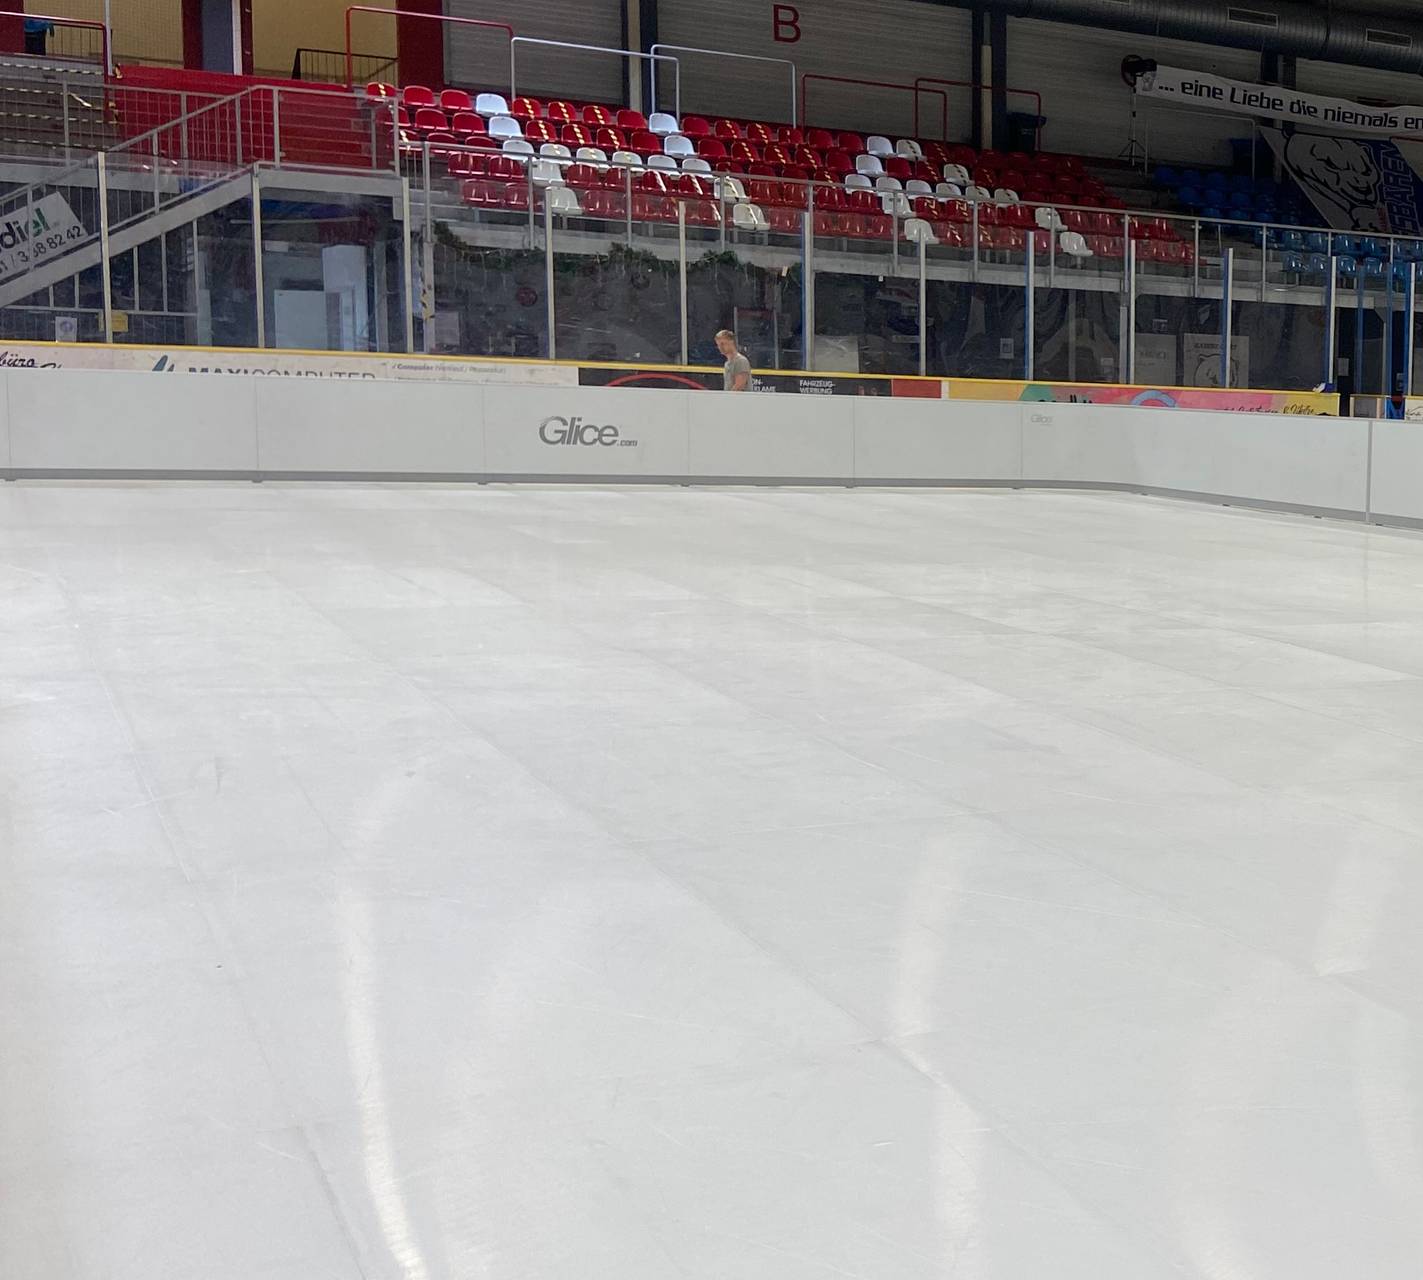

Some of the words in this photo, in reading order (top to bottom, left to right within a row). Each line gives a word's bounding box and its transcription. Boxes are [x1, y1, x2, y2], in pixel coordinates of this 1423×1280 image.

[773, 4, 801, 43] B
[1180, 80, 1224, 100] eine
[1229, 86, 1284, 112] Liebe
[1289, 98, 1318, 118] die
[1323, 107, 1399, 129] niemals
